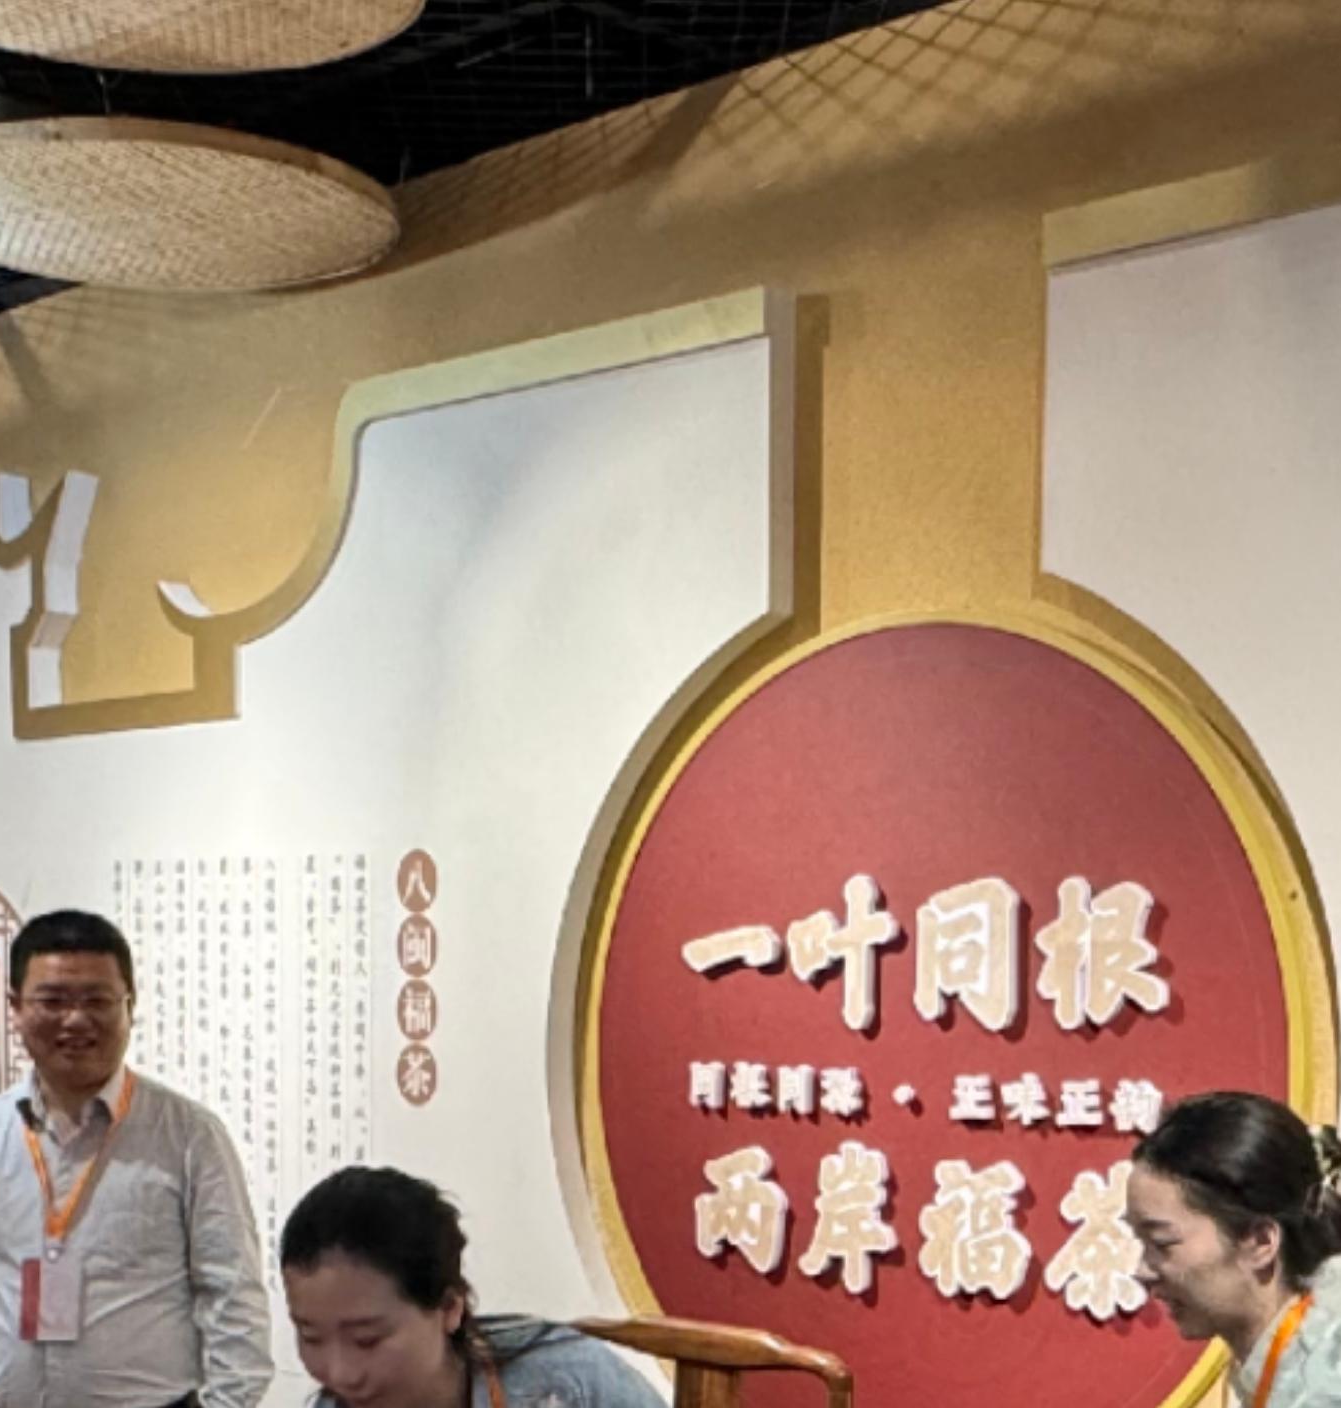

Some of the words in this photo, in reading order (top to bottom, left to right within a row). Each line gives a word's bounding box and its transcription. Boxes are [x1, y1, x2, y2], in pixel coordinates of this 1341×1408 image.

[682, 874, 1170, 1031] 一叶同根
[693, 1141, 1147, 1320] 两岸福茶
